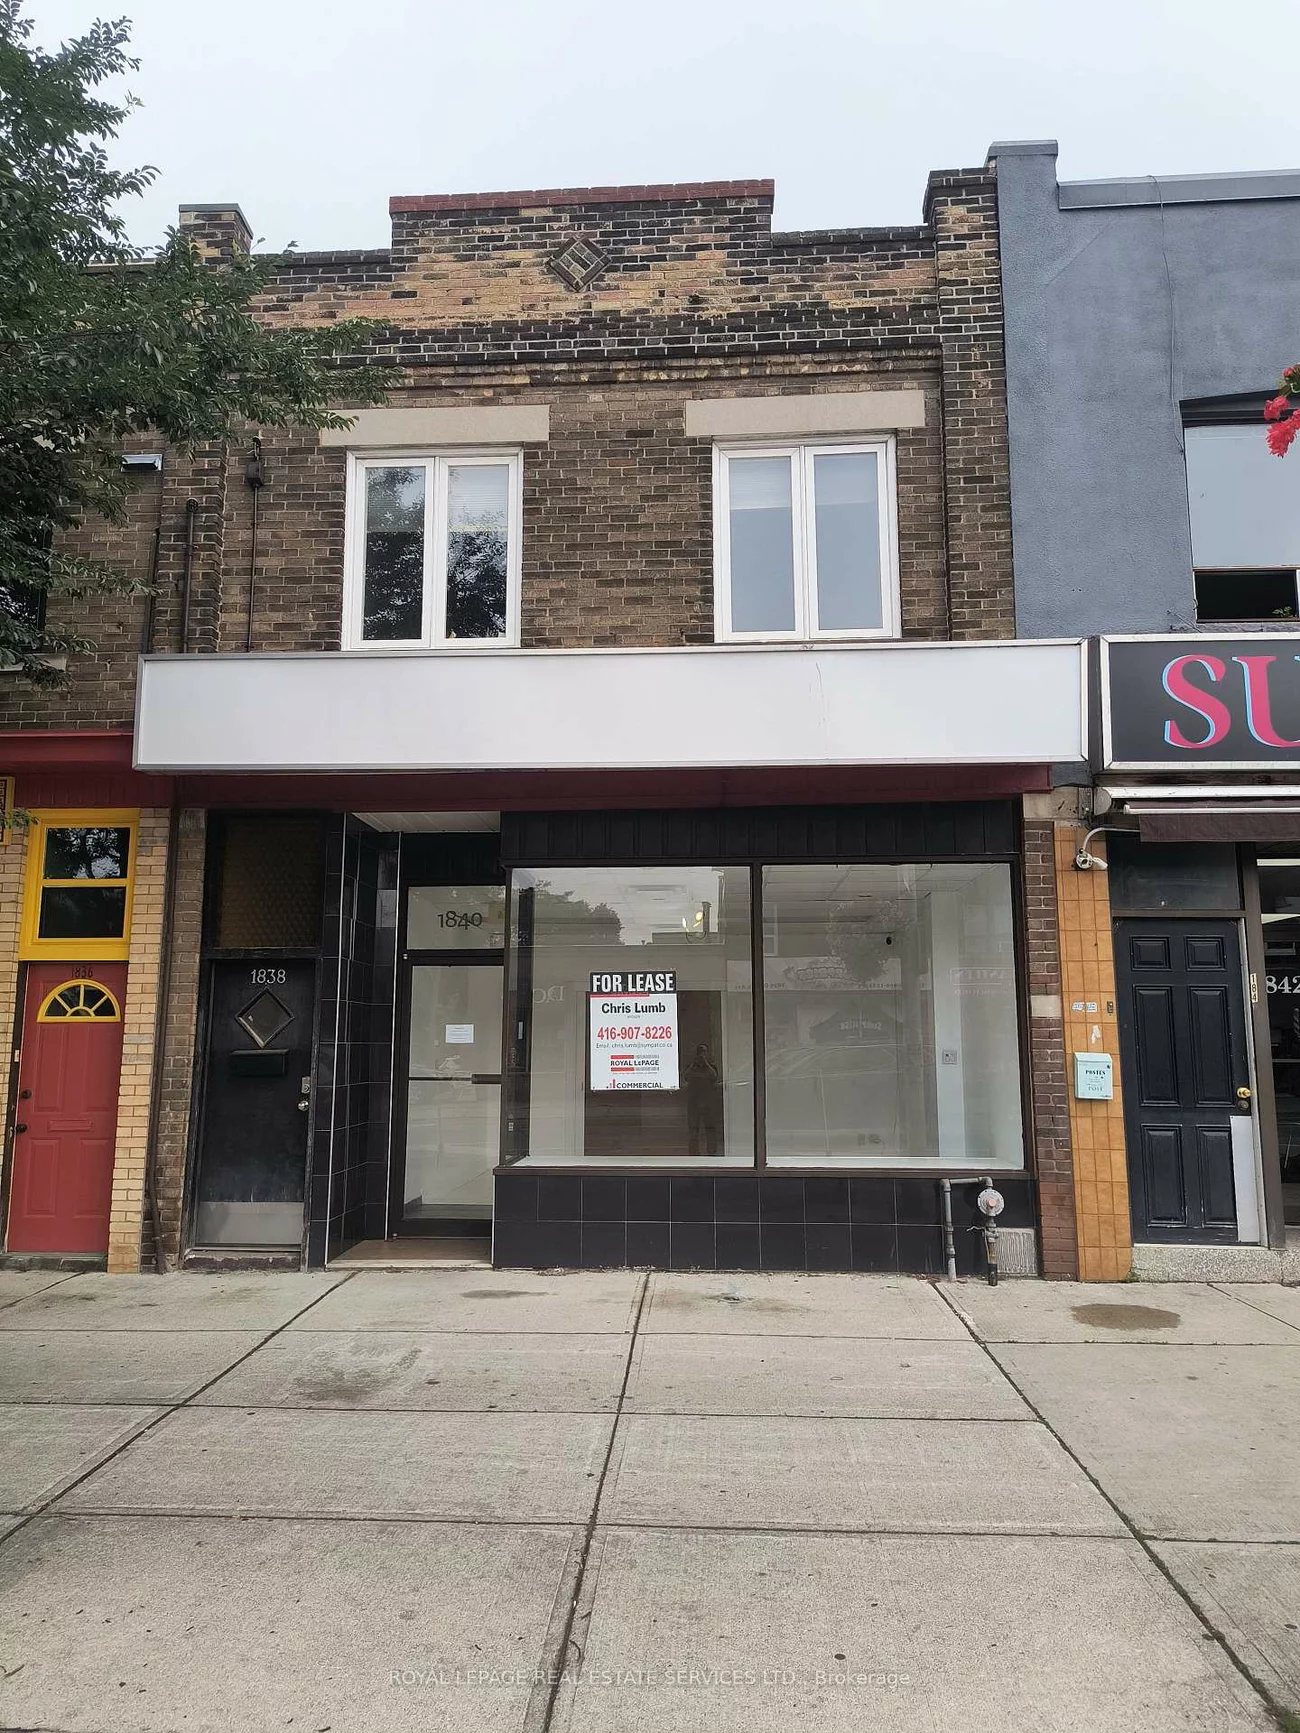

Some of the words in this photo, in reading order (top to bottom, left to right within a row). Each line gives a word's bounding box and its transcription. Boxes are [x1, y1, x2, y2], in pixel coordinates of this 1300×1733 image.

[437, 911, 482, 930] 1840
[71, 967, 93, 978] 1836
[250, 969, 286, 984] 1838
[592, 974, 622, 993] FOR
[627, 973, 674, 992] LEASE
[601, 1002, 631, 1014] Chris
[634, 1002, 666, 1013] Lumb
[597, 1026, 672, 1040] 416-907-8226
